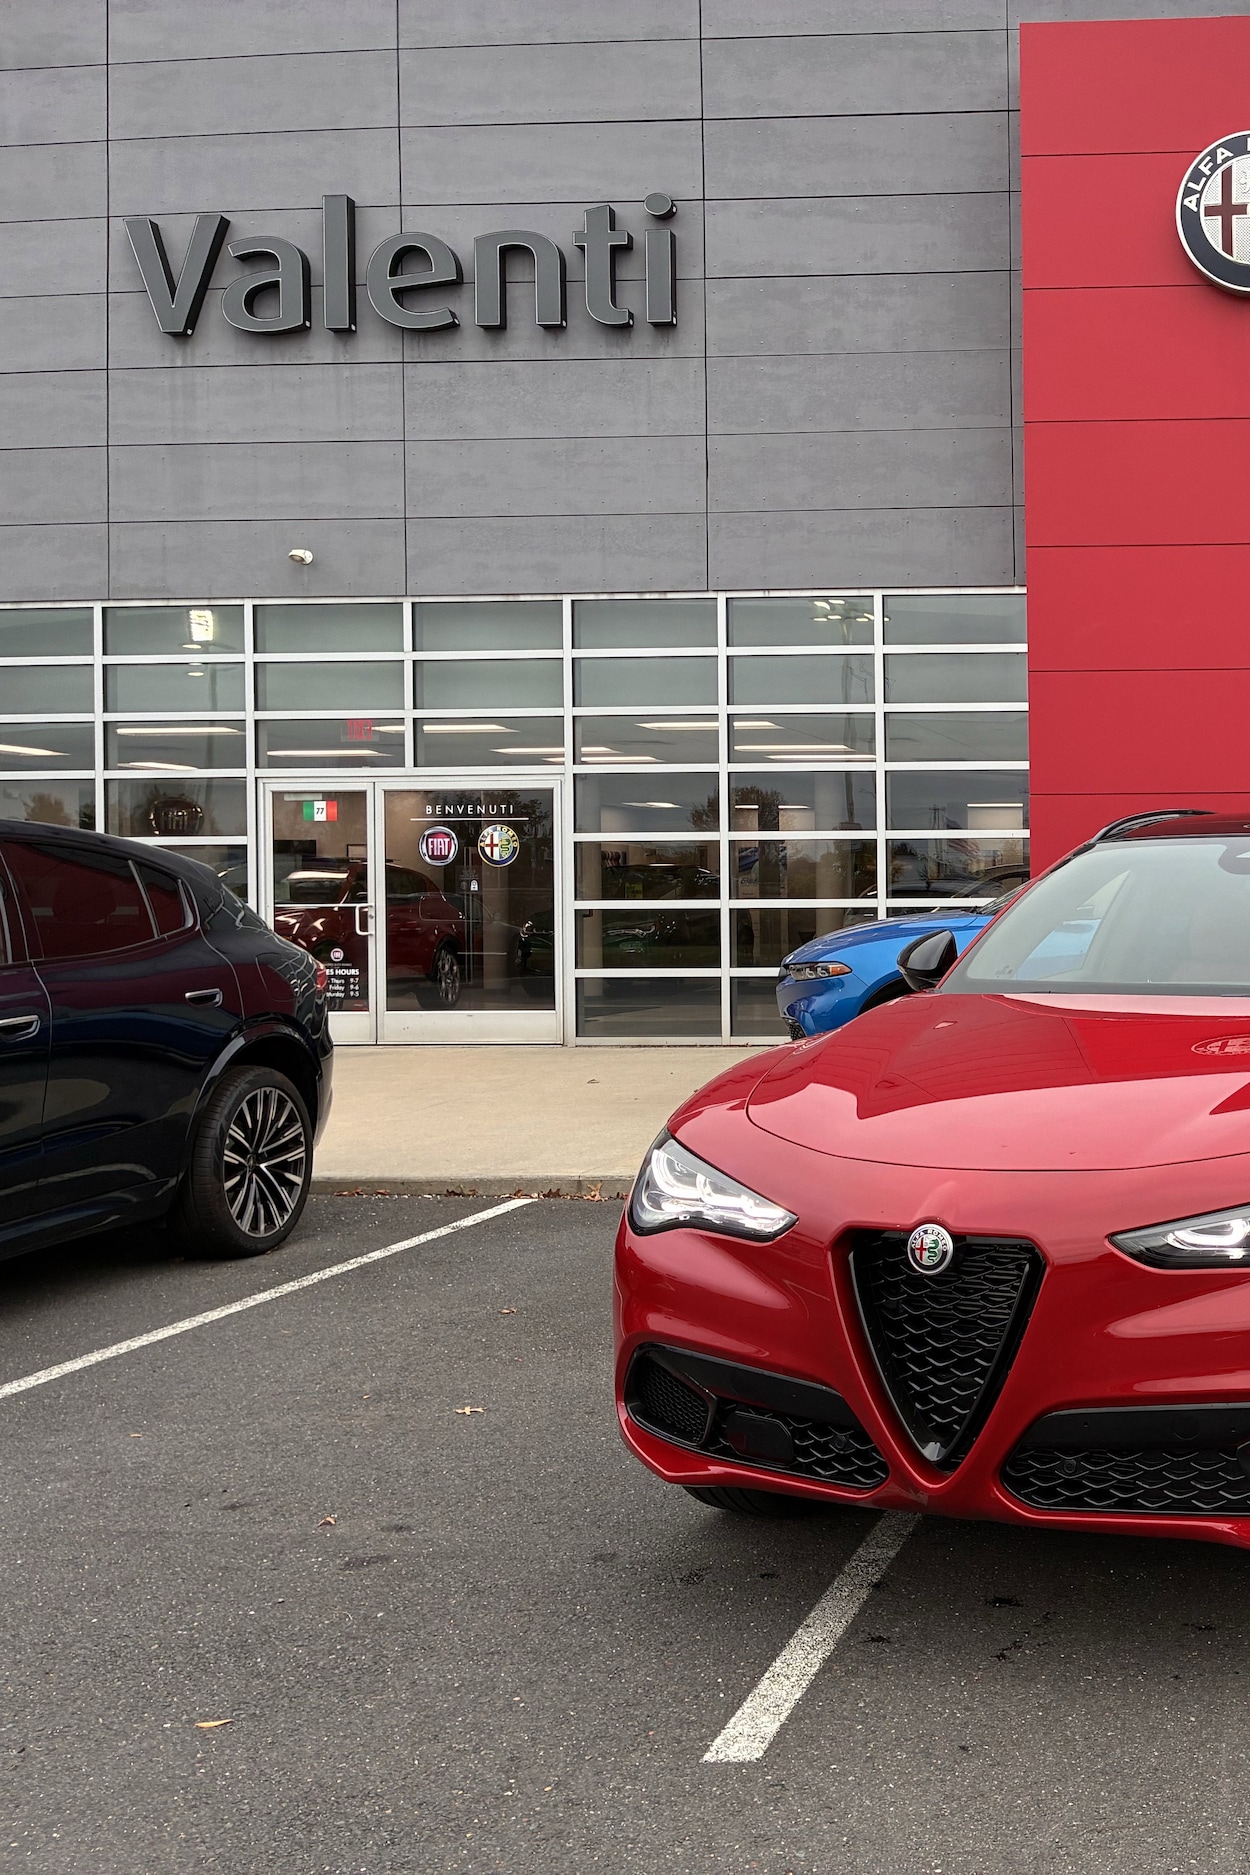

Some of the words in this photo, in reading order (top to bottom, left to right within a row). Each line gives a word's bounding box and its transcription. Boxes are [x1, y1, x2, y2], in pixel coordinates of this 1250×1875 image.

[1183, 147, 1234, 212] ALFA
[123, 192, 677, 336] Valenti
[315, 807, 325, 815] 77
[425, 804, 514, 815] BENVENUTI
[427, 838, 451, 856] FIAT
[496, 826, 518, 848] ROMEO
